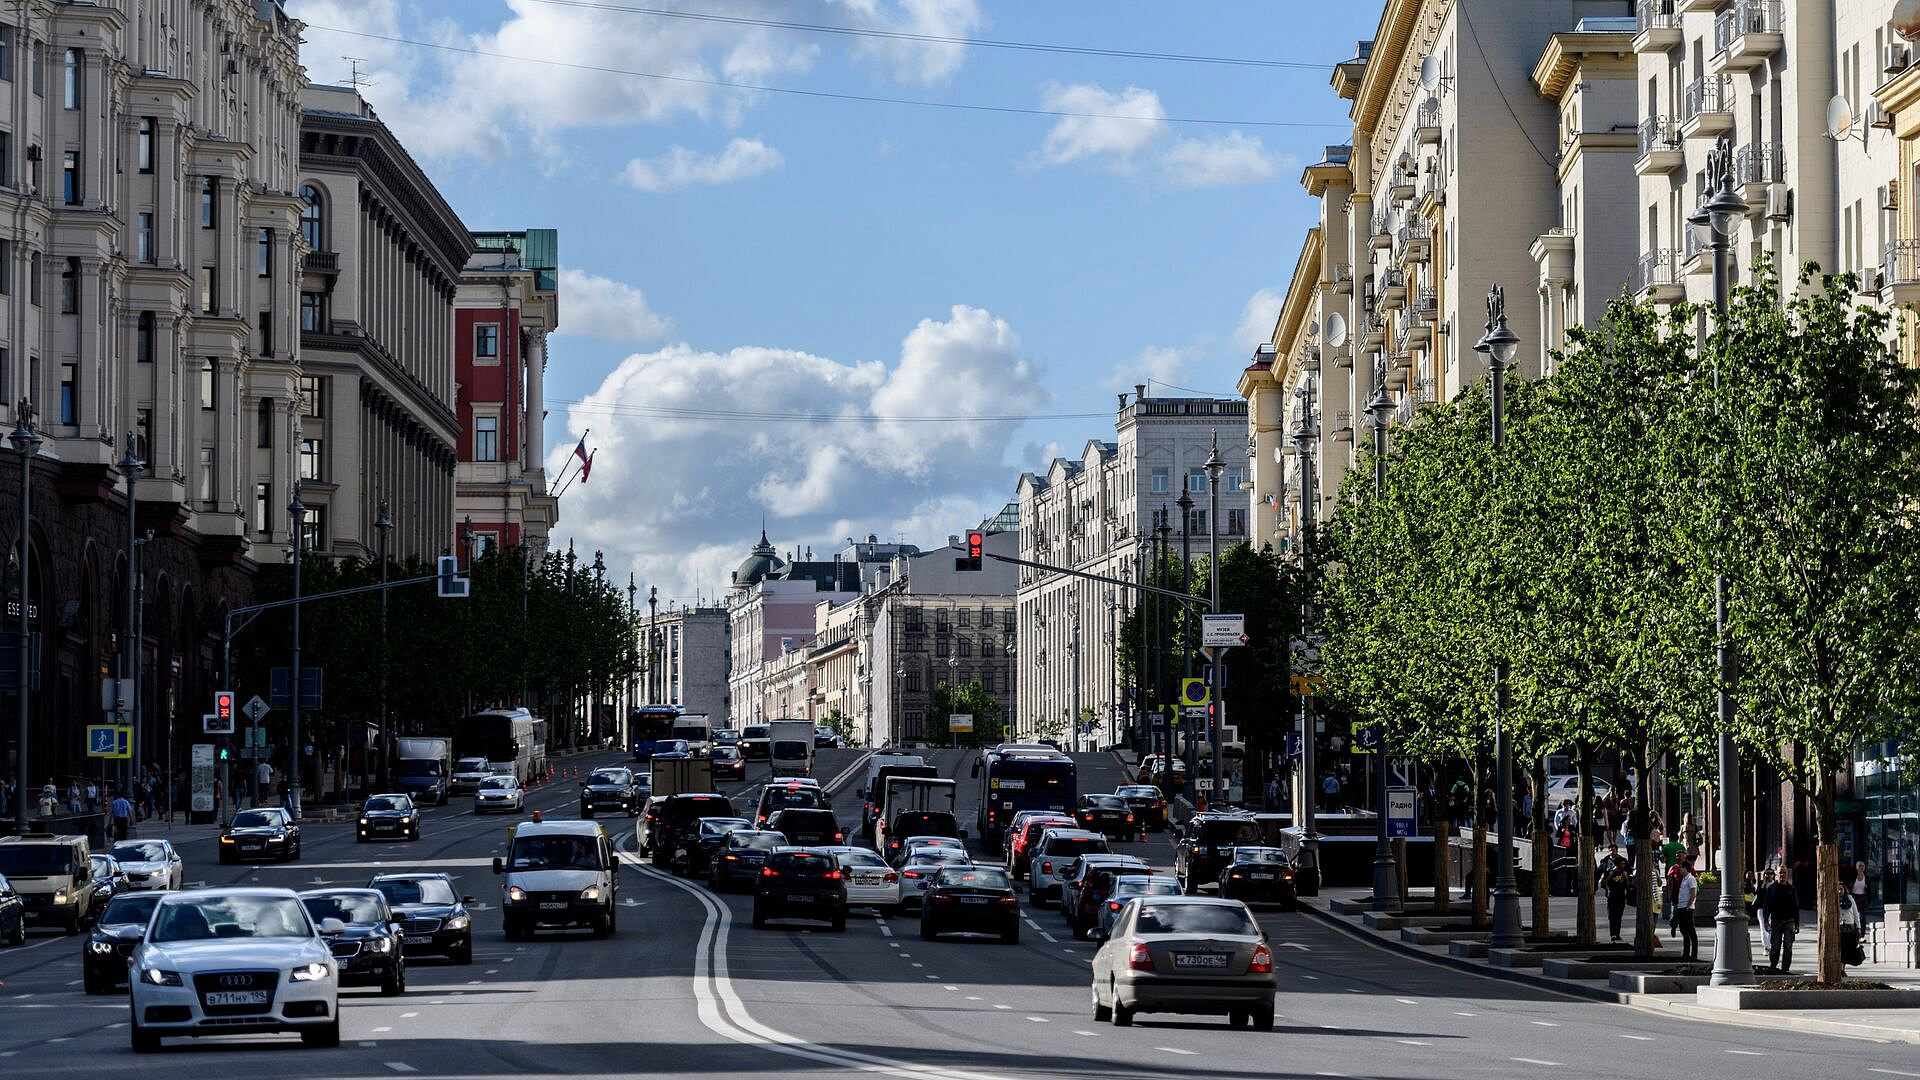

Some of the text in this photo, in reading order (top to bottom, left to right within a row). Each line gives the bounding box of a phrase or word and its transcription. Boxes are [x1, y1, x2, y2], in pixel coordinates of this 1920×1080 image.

[8, 602, 38, 618] ESEED
[1200, 780, 1225, 788] СТ
[1390, 801, 1412, 809] Радио
